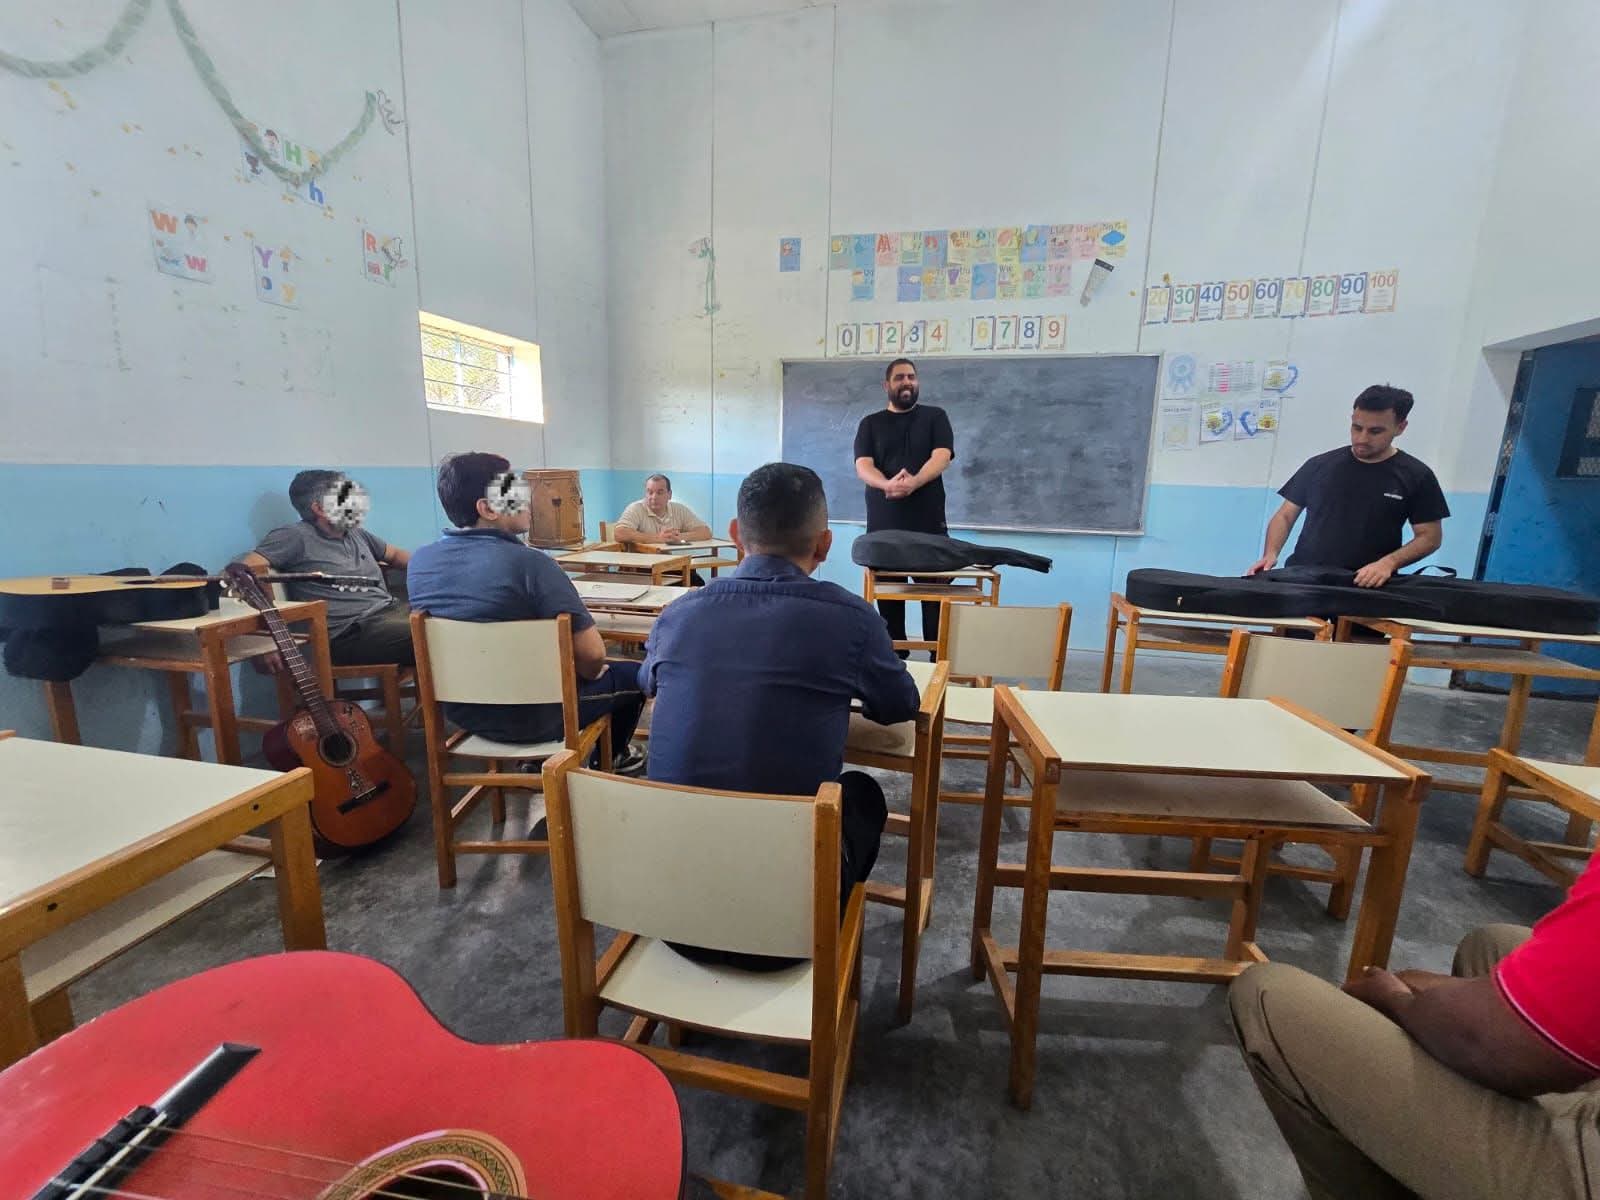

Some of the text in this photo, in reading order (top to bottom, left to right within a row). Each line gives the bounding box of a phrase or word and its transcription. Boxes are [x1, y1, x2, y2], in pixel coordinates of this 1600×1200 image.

[286, 141, 303, 166] H
[309, 180, 324, 204] h
[151, 210, 178, 233] W
[365, 232, 378, 253] R
[256, 246, 273, 268] Y
[1150, 273, 1396, 306] 20 30 40 50 60 70 80 90 100
[841, 324, 943, 347] 0 1 2 3 4
[976, 320, 1060, 341] 6 7 8 9
